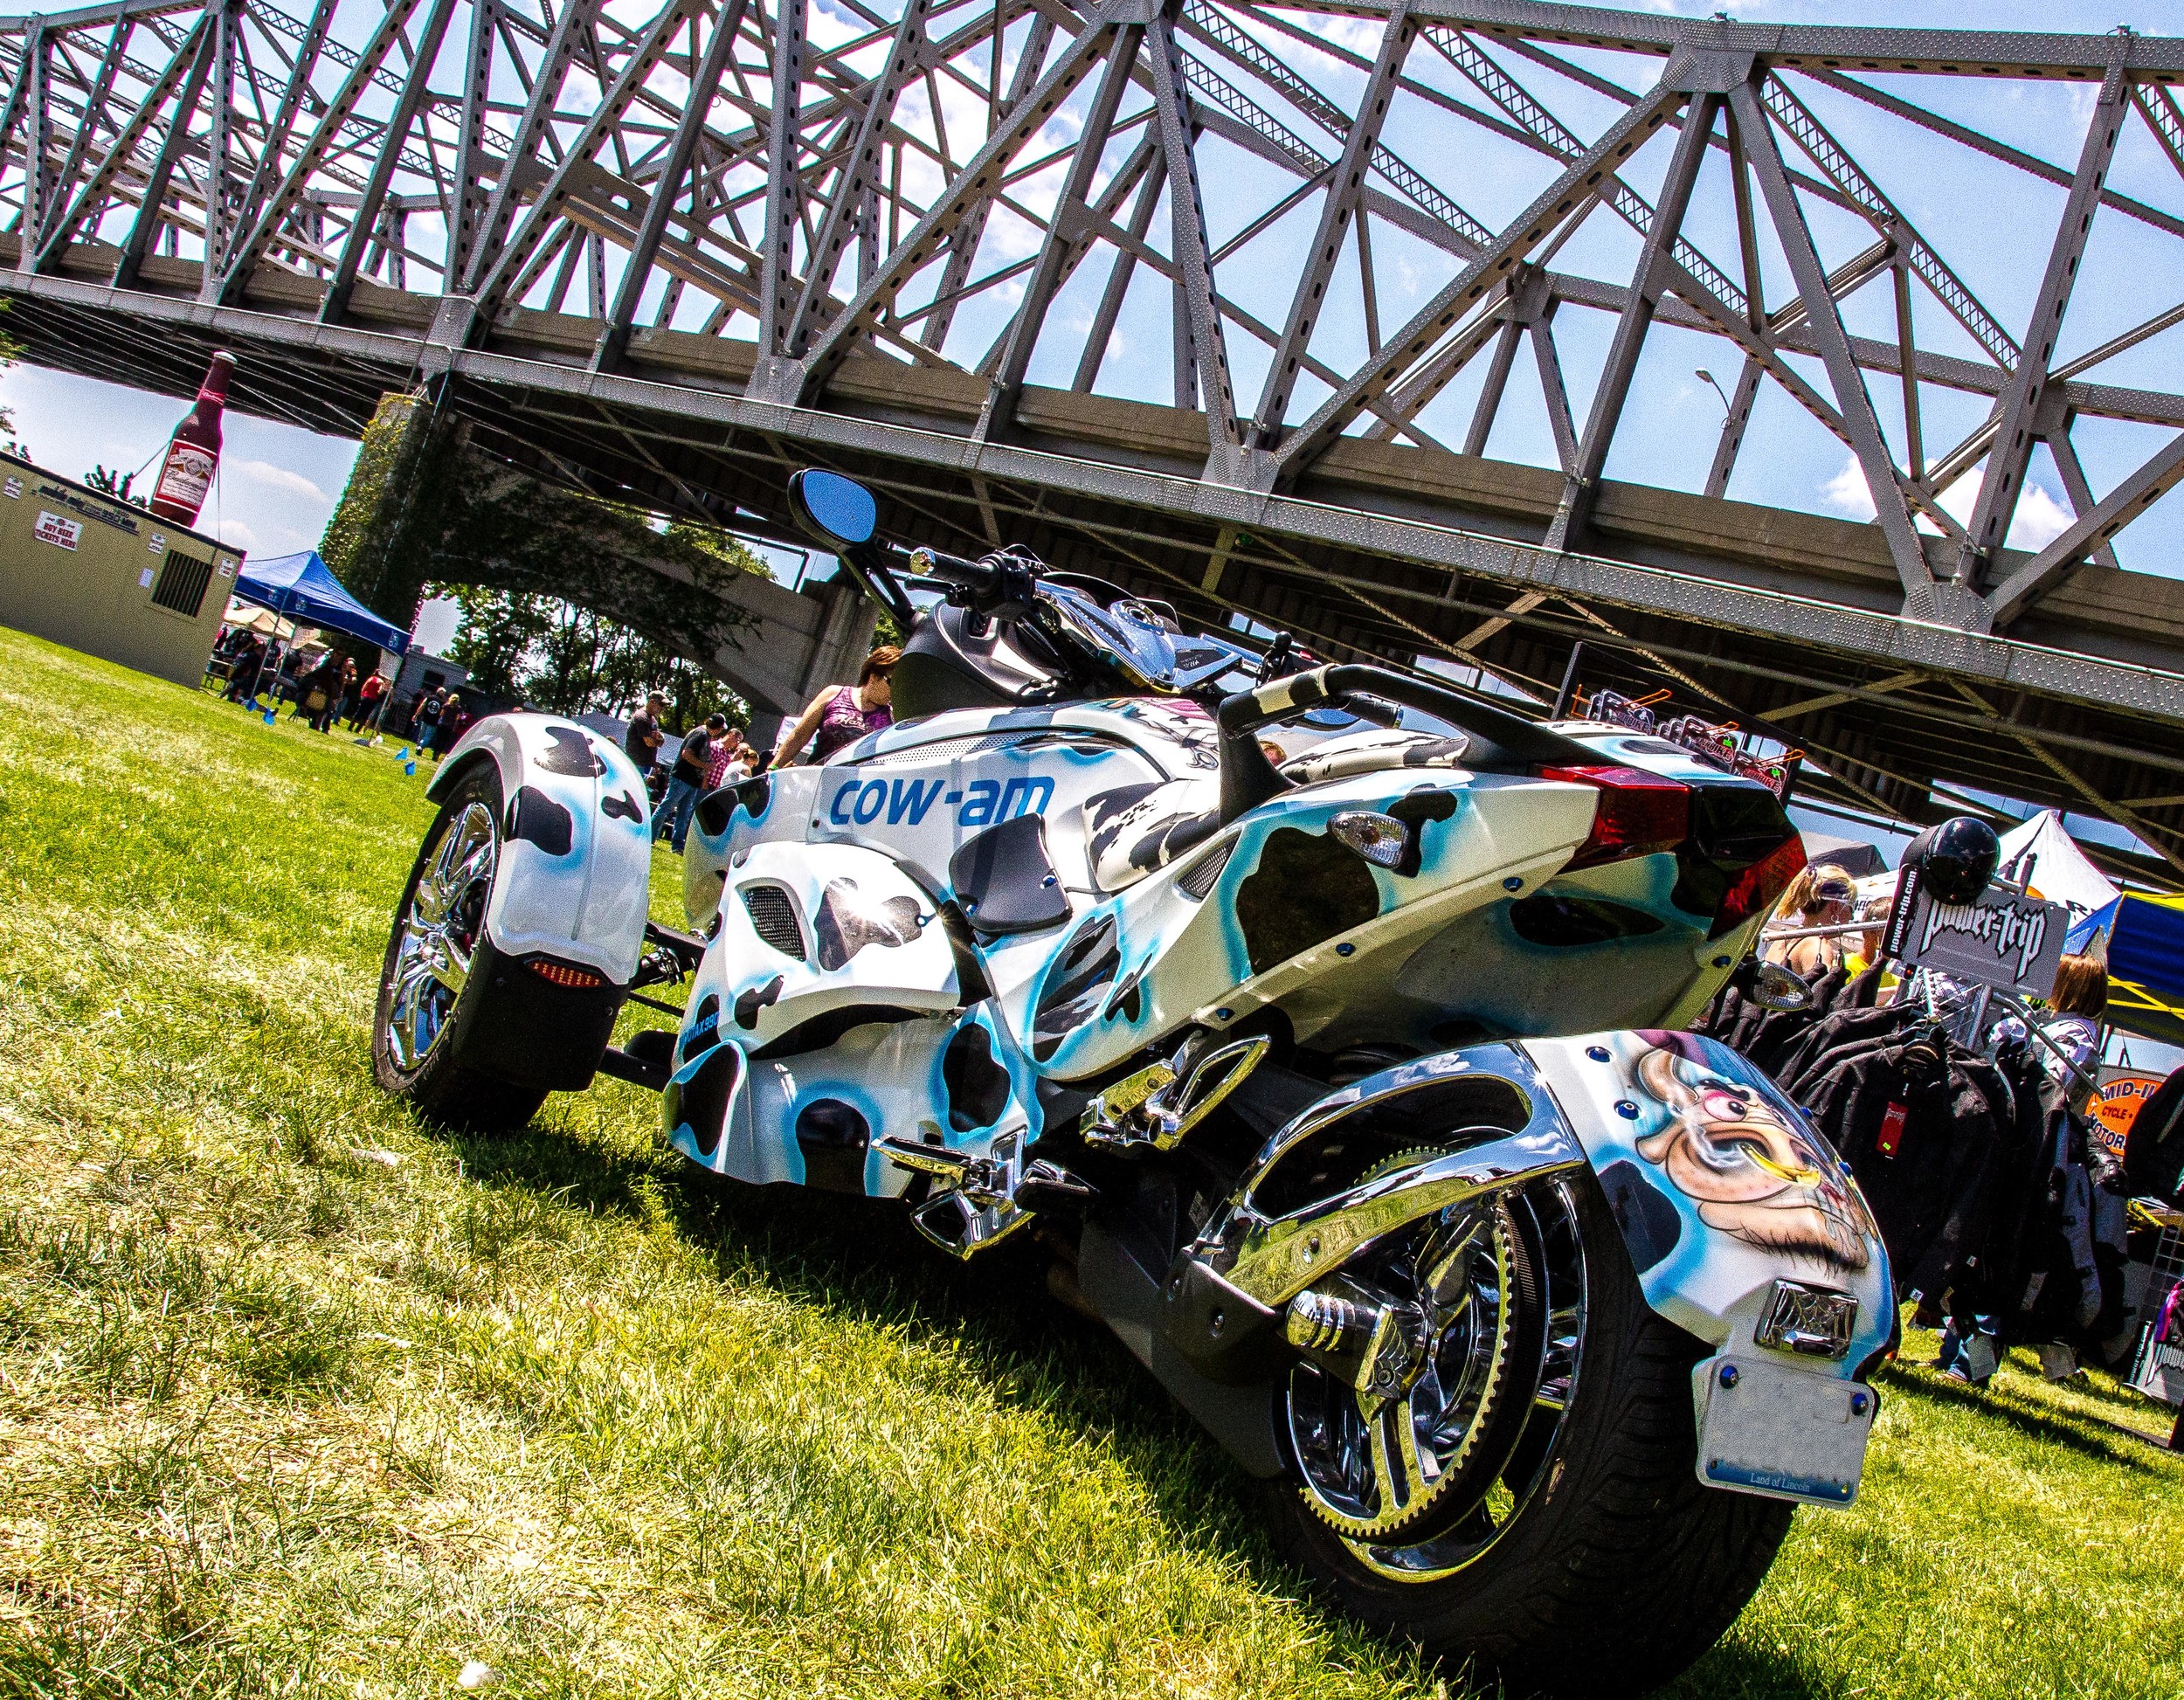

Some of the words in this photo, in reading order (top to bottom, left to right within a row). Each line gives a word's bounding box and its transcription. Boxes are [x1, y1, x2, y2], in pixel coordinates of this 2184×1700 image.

[35, 529, 60, 543] TICKETS
[60, 536, 77, 549] HERE
[44, 522, 57, 534] BUY
[58, 527, 74, 539] BEER
[2102, 1105, 2128, 1120] CYCLE
[1750, 1472, 1770, 1485] Land
[1772, 1476, 1781, 1488] of
[1781, 1475, 1810, 1493] Lincoln
